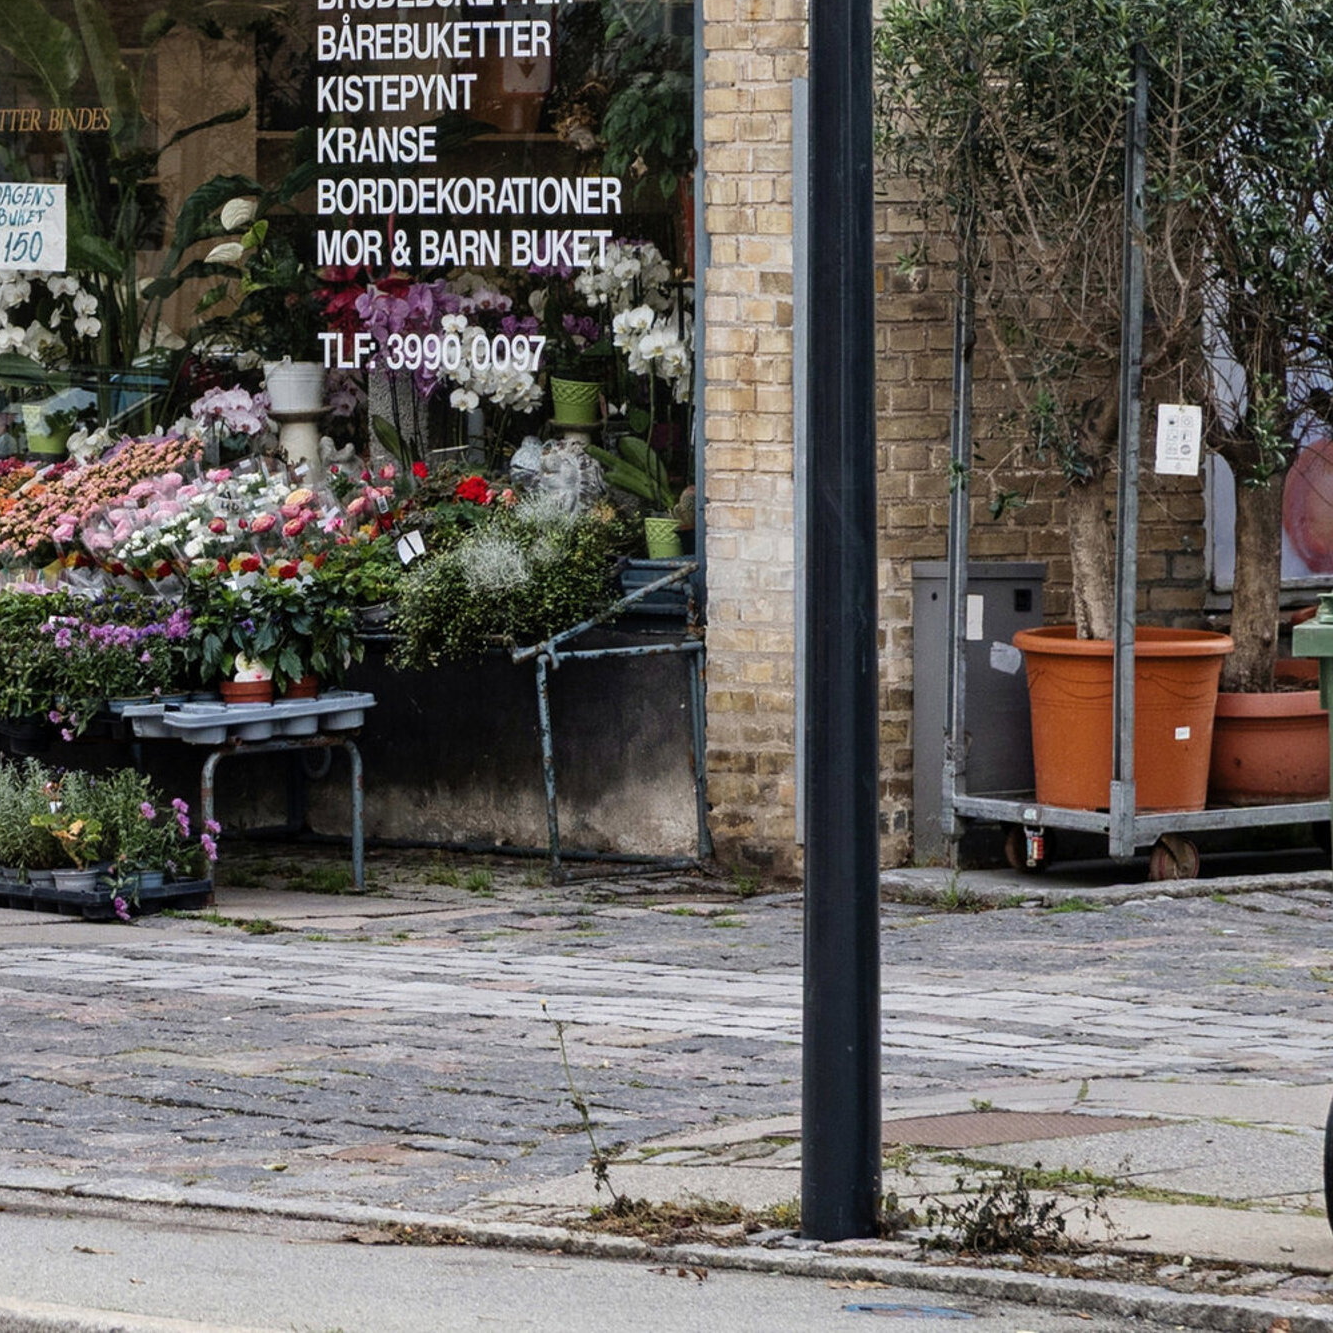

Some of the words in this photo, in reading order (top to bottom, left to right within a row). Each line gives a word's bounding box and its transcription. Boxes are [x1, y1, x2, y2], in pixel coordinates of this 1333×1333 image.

[317, 13, 551, 61] BÅREBUKETTER
[317, 74, 478, 113] KISTEPYNT
[47, 107, 112, 131] BINDES
[317, 126, 438, 164] KRANSE
[317, 177, 622, 215] BORDDEKORATIONER
[4, 230, 44, 263] 150
[317, 230, 383, 267] MOR
[393, 230, 412, 267] &
[420, 230, 500, 267] BARN
[511, 229, 613, 267] BUKET
[318, 332, 377, 370] TLF:
[386, 333, 462, 370] 3990
[470, 333, 547, 372] 0097
